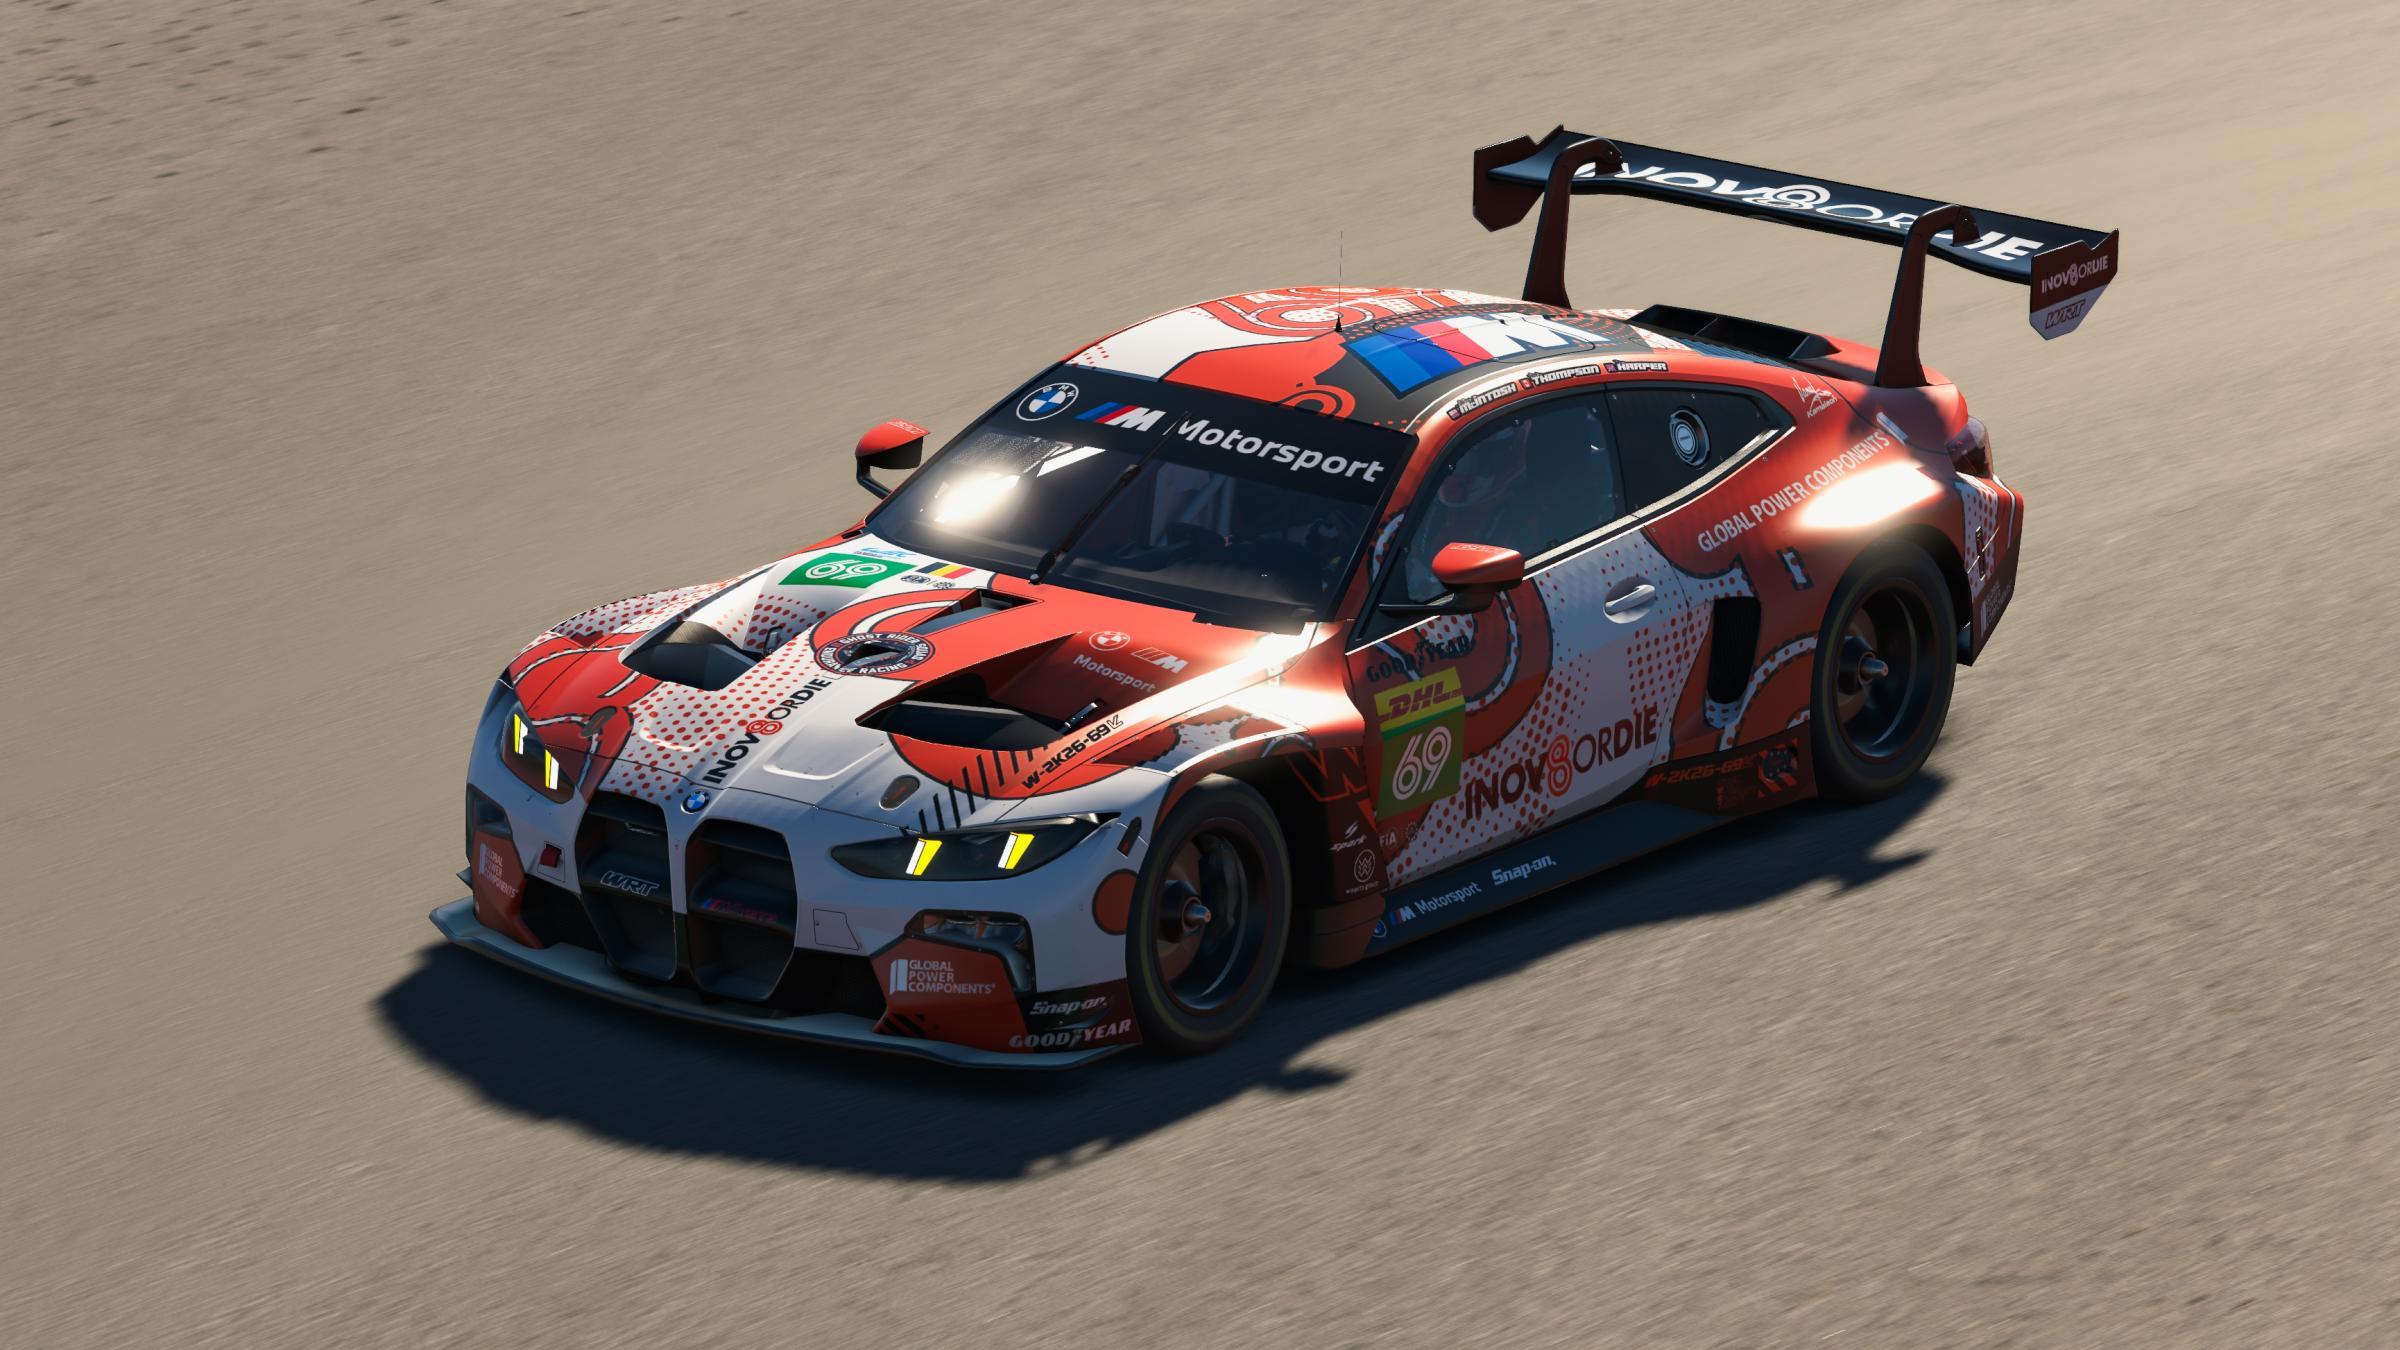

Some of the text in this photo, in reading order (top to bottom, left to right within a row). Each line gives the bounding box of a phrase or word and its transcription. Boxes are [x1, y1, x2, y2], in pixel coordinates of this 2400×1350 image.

[1573, 162, 2045, 261] INOV8ORIE
[2045, 299, 2086, 329] WRT
[1532, 365, 1601, 385] THOMPSON
[1617, 361, 1668, 372] HARPER
[1178, 418, 1385, 484] Motorsport
[1698, 431, 1890, 552] GLOBAL POWER COMPONENTS
[805, 559, 888, 580] 69
[859, 662, 908, 674] RACING
[1073, 654, 1156, 693] Motorsport
[1389, 681, 1445, 719] DHL
[702, 678, 832, 784] INOV8ORDIE
[1392, 726, 1452, 800] 69
[1465, 702, 1658, 820] INOV8ORDIE
[599, 870, 660, 896] WRT
[1414, 881, 1483, 915] Motorsport
[908, 971, 955, 983] POWER
[909, 959, 954, 972] GLOBAL
[908, 982, 993, 994] COMPONENTS
[1009, 1018, 1131, 1048] GOODYEAR
